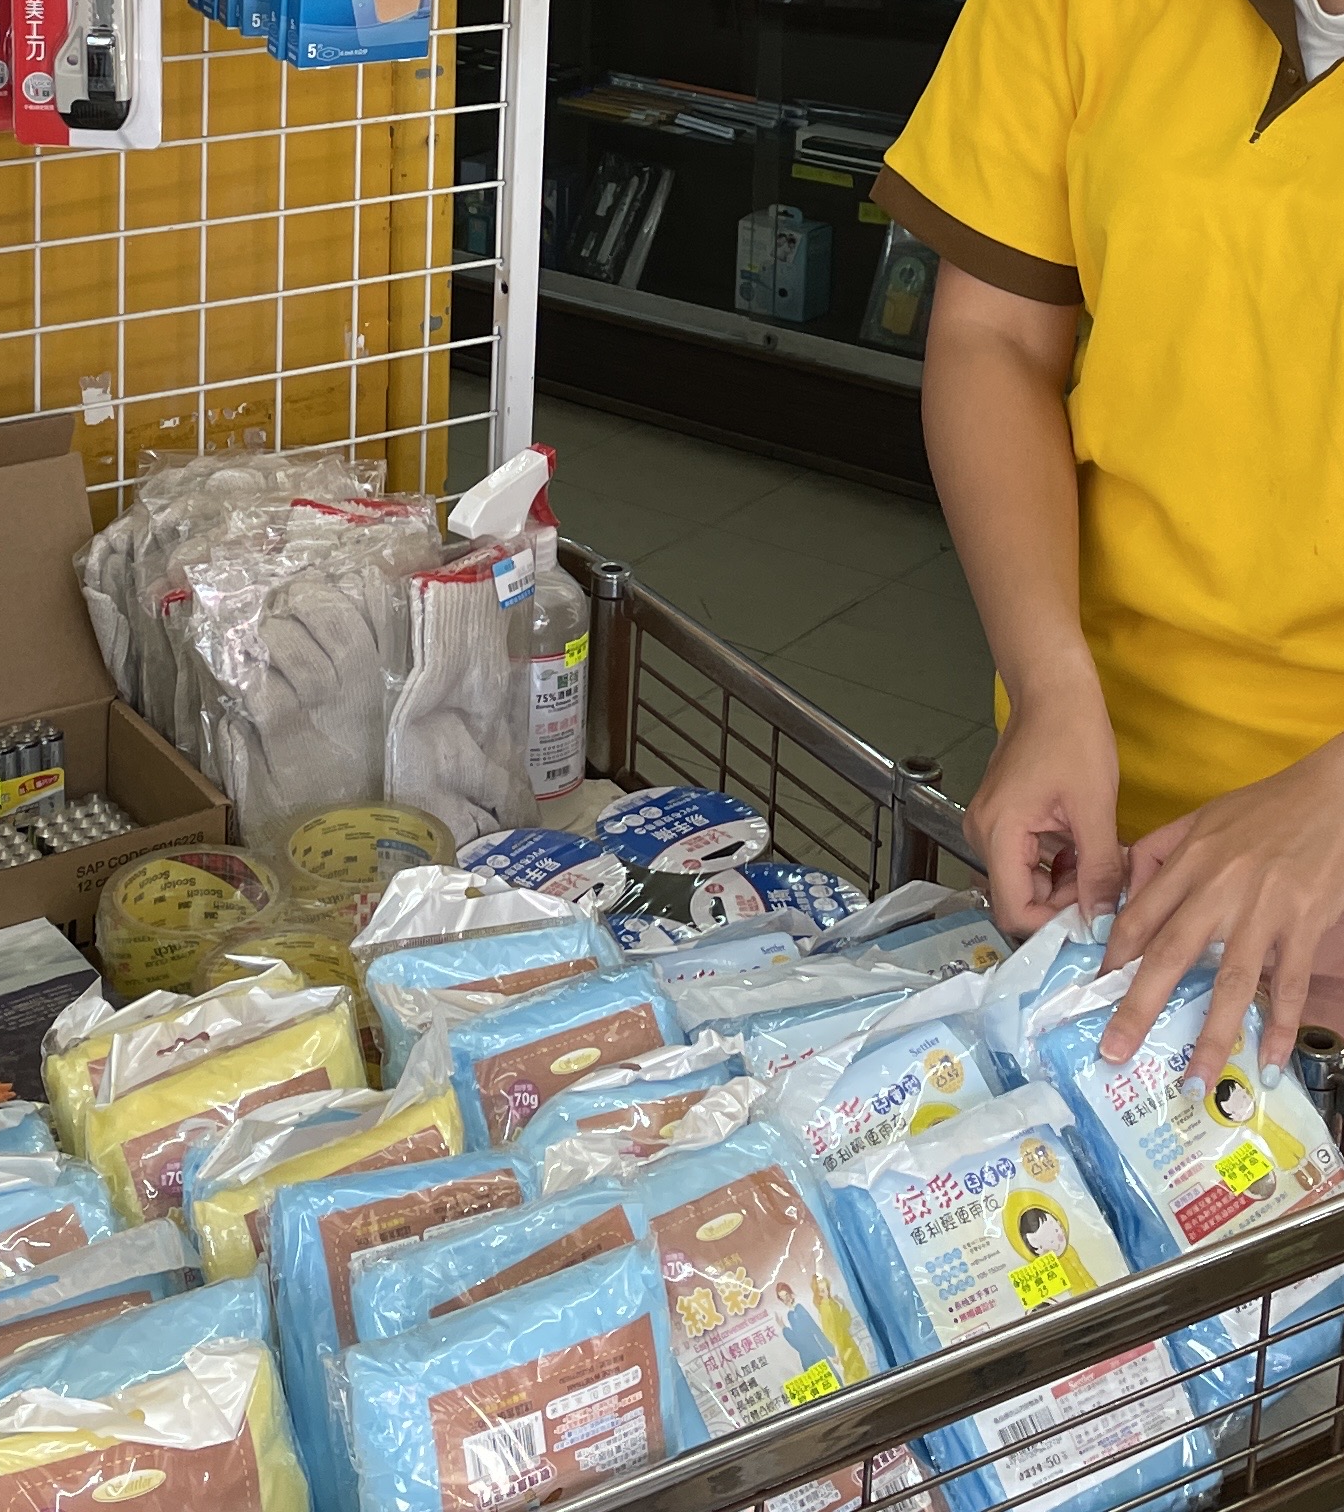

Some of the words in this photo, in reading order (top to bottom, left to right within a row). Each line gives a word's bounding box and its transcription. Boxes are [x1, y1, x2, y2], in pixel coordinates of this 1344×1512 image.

[159, 876, 196, 892] Scotch
[186, 887, 223, 900] Scotch
[909, 1036, 941, 1058] Settler
[703, 1324, 780, 1373] 成人輕便雨衣
